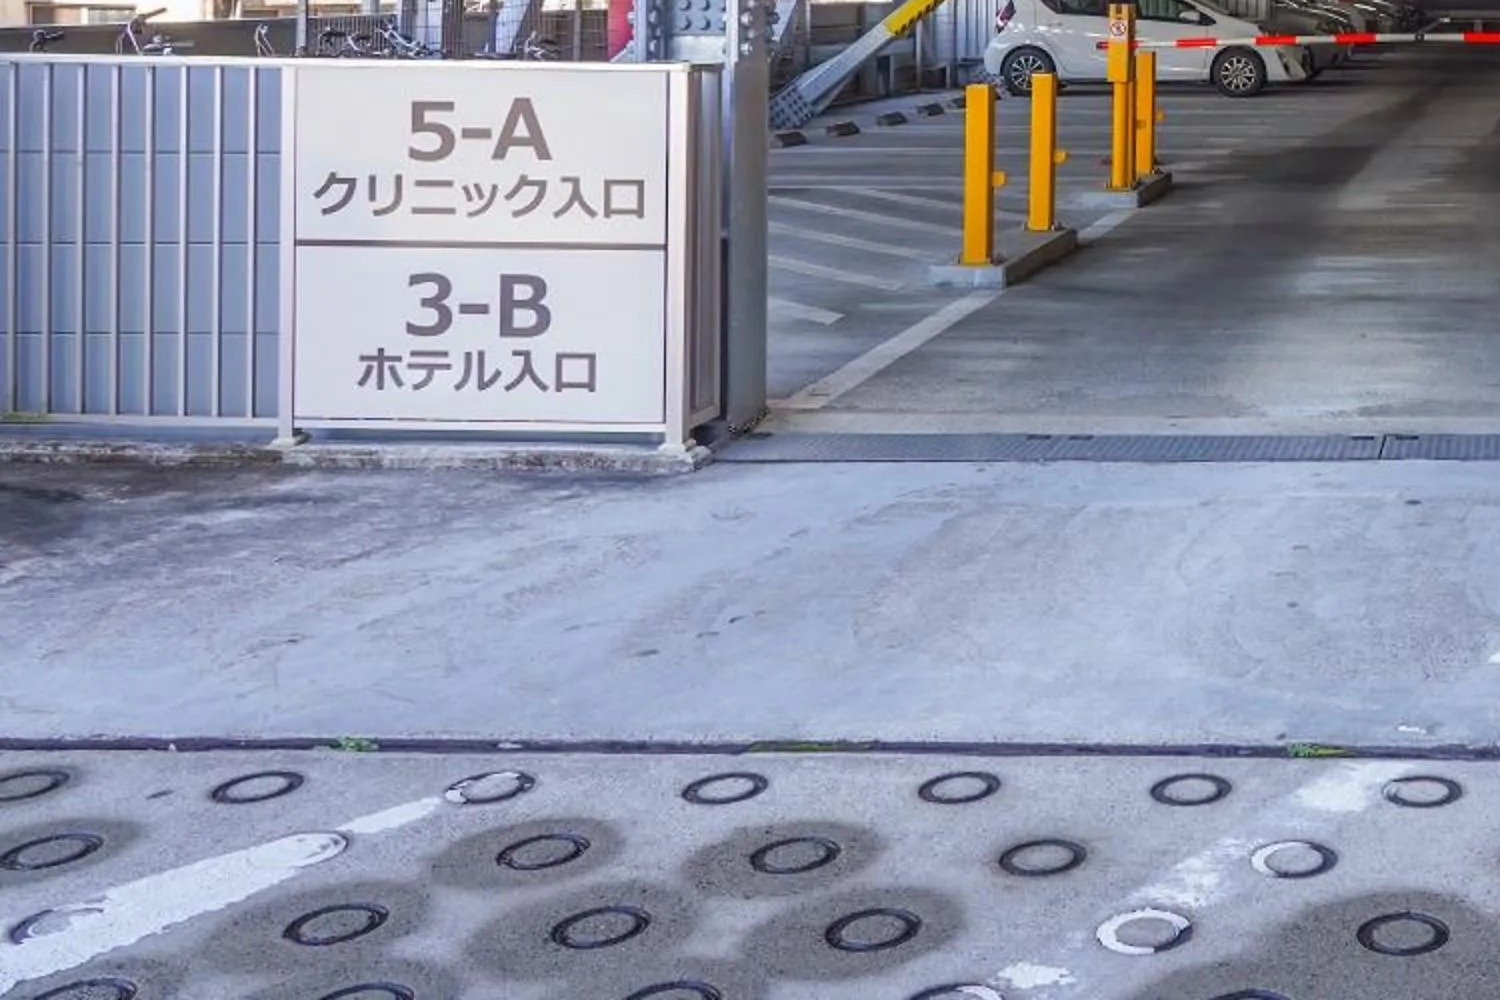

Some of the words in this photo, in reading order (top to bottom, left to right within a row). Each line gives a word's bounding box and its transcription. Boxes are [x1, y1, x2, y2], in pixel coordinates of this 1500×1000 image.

[407, 96, 552, 162] 5-A
[313, 171, 645, 219] クリニック入口
[405, 272, 552, 338] 3-B
[357, 347, 597, 393] ホテル入口
